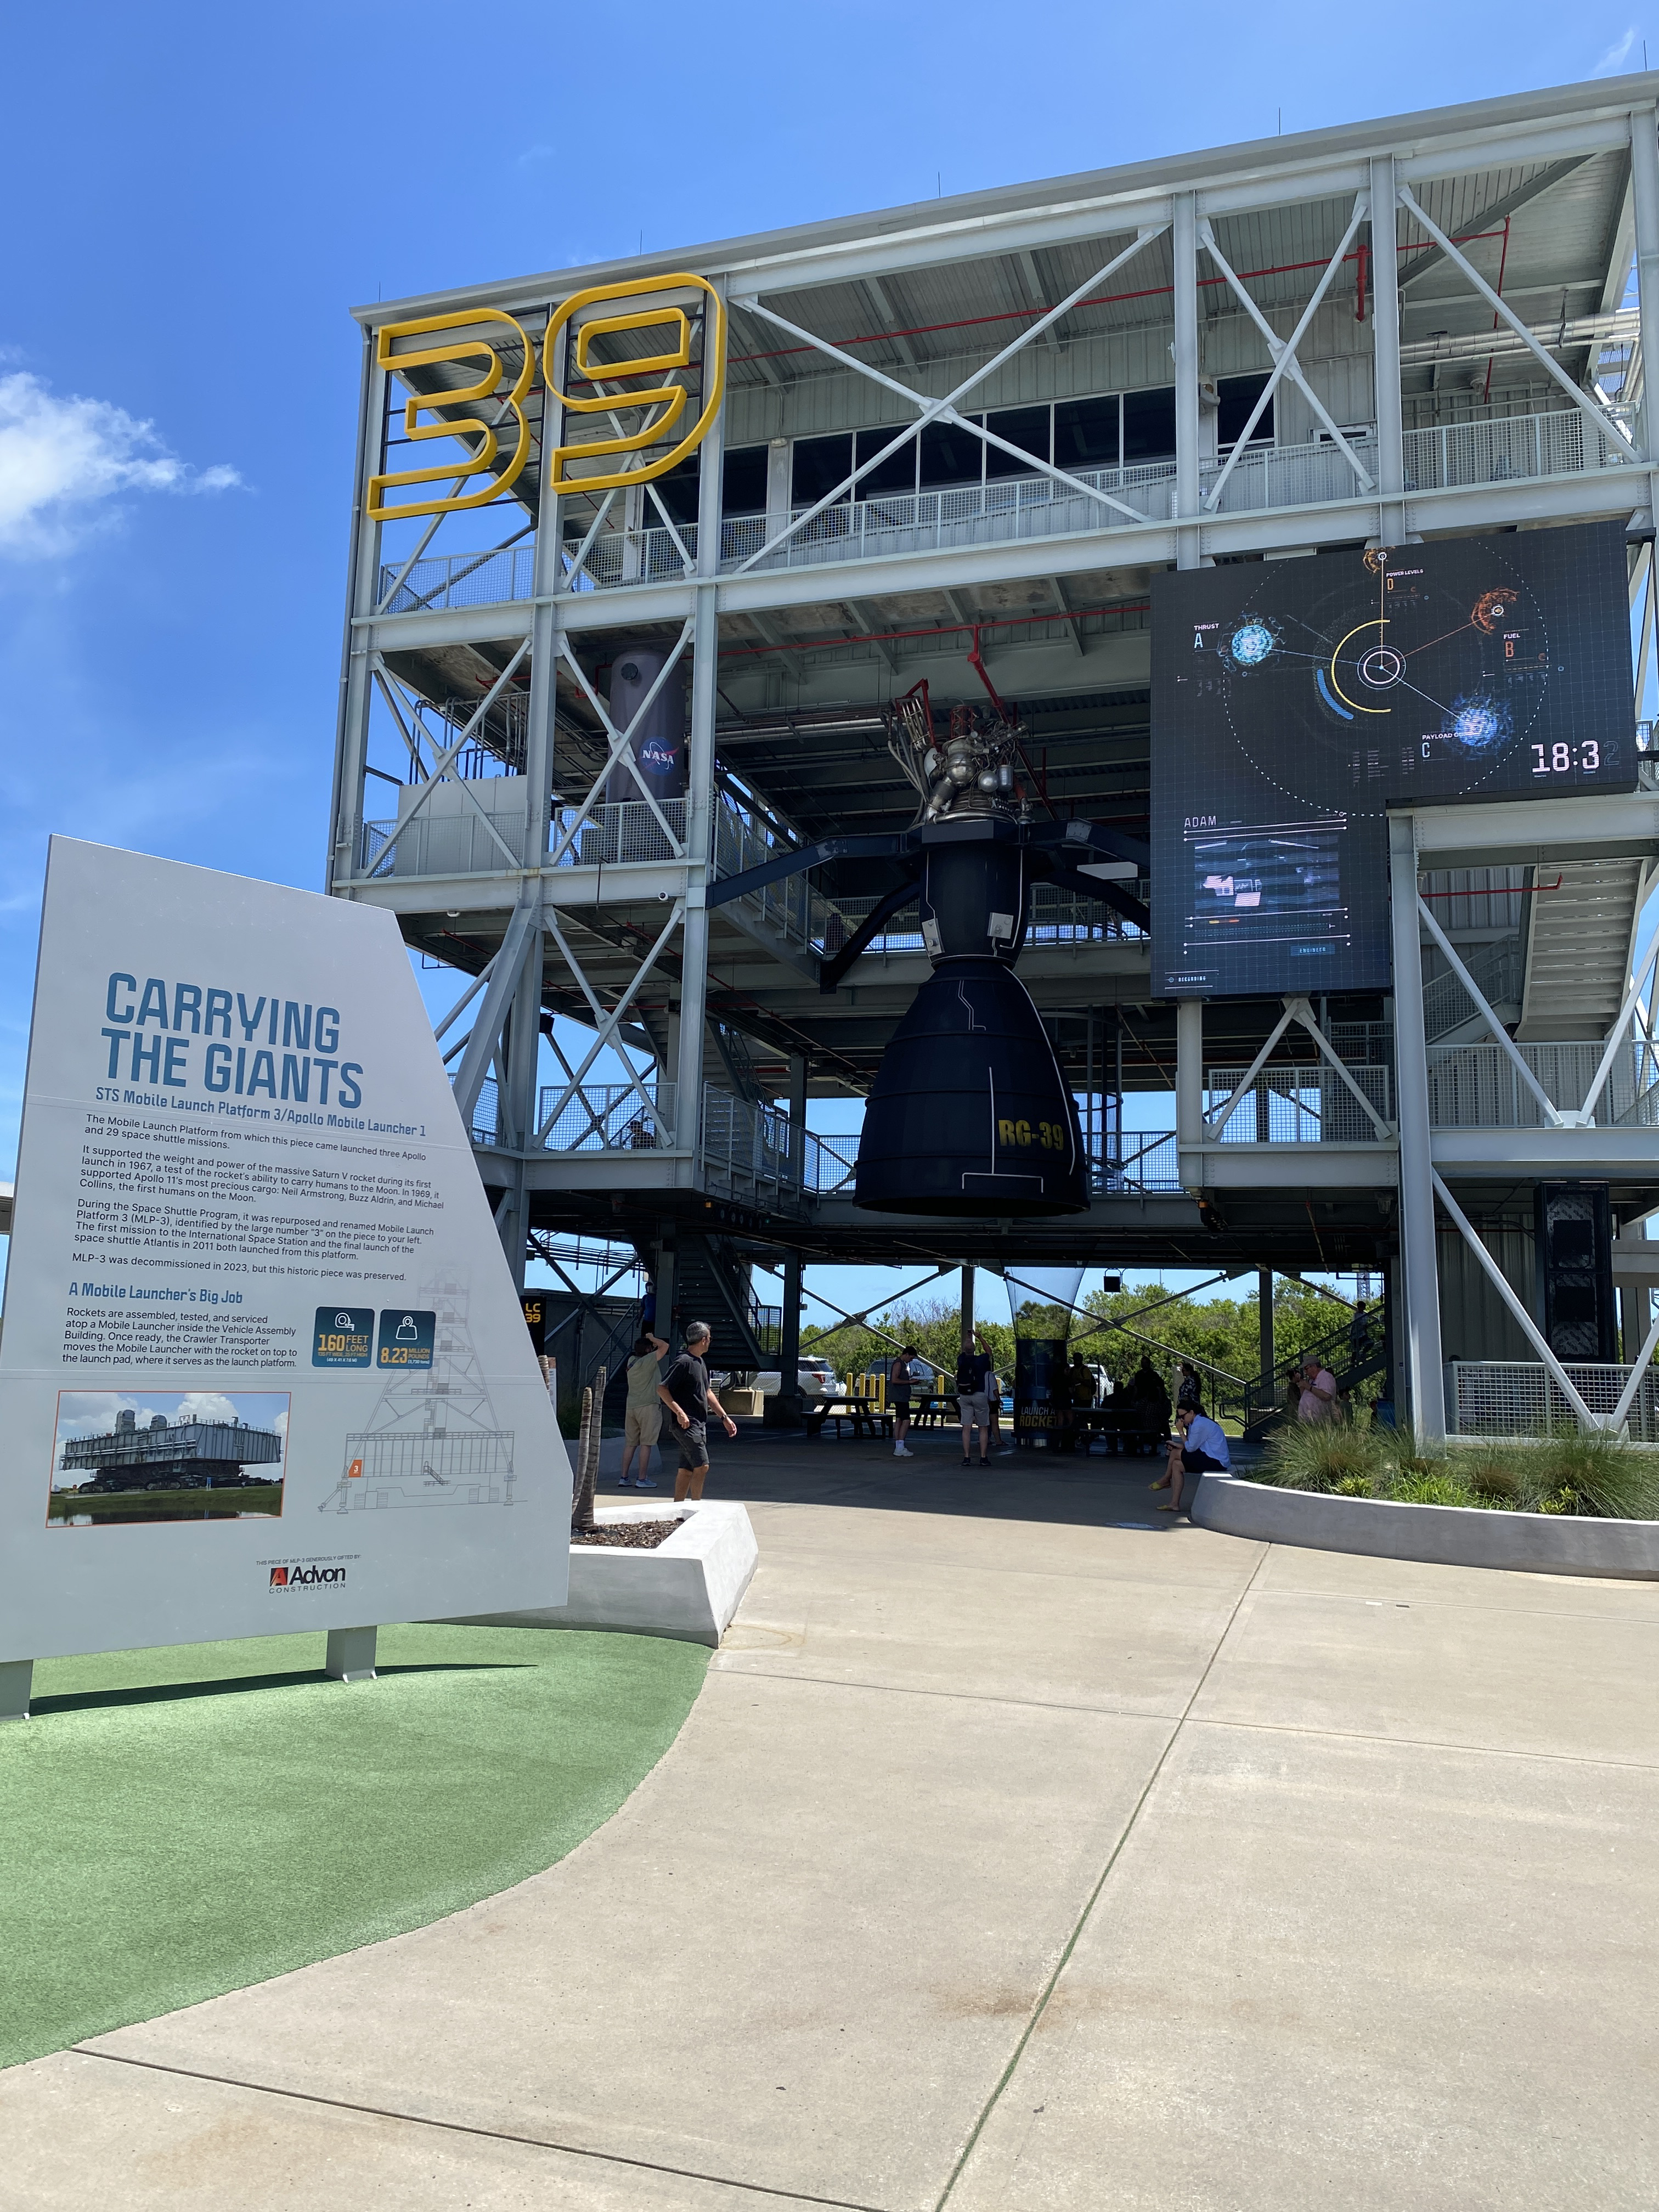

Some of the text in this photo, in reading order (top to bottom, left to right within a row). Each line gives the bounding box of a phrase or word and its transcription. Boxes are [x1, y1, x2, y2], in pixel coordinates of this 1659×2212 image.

[367, 273, 727, 522] 39
[1194, 633, 1203, 648] A
[1505, 641, 1514, 657] B
[642, 749, 674, 765] NASA
[1421, 742, 1431, 758] C
[1184, 815, 1217, 828] ADAM
[106, 972, 340, 1054] CARRYING
[101, 1028, 364, 1109] THE GIANTS
[95, 1087, 425, 1136] STS Mobile Launch Platform 3/Apollo Mobile Launcher 1
[86, 1114, 104, 1124] The
[108, 1116, 139, 1127] Mobile
[143, 1120, 176, 1132] Launch
[179, 1125, 218, 1137] Platform
[221, 1130, 241, 1139] from
[244, 1133, 269, 1142] which
[272, 1136, 287, 1144] this
[290, 1138, 313, 1148] piece
[340, 1144, 377, 1155] launched
[379, 1149, 399, 1158] three
[402, 1151, 426, 1160] Apollo
[998, 1120, 1064, 1150] RG-39
[76, 1210, 118, 1221] Platform
[131, 1213, 172, 1227] (MLP-3),
[175, 1217, 218, 1228] identified
[221, 1221, 232, 1231] by
[234, 1223, 249, 1231] the
[251, 1224, 273, 1234] large
[338, 1231, 351, 1239] the
[78, 1198, 110, 1211] During
[113, 1201, 128, 1210] the
[132, 1203, 161, 1214] Space
[164, 1206, 197, 1216] Shuttle
[200, 1209, 240, 1221] Program,
[271, 1216, 320, 1226] repurposed
[378, 1223, 404, 1233] Mobile
[406, 1226, 433, 1235] Launch
[69, 1282, 242, 1304] A Mobile Launcher's Big Job
[67, 1307, 105, 1317] Rockets
[126, 1311, 177, 1321] assembled,
[180, 1312, 210, 1323] tested,
[231, 1314, 267, 1323] serviced
[526, 1303, 541, 1312] LC
[525, 1313, 541, 1323] 39
[65, 1319, 87, 1329] atop
[98, 1320, 129, 1329] Mobile
[132, 1321, 174, 1330] Launcher
[177, 1323, 203, 1331] inside
[222, 1324, 253, 1334] Vehicle
[255, 1326, 296, 1336] Assembly
[65, 1330, 270, 1346] Building. Once ready, the Crawler Transporter
[318, 1334, 369, 1352] 160 FEET
[98, 1343, 113, 1351] the
[116, 1344, 147, 1352] Mobile
[150, 1345, 191, 1353] Launcher
[194, 1346, 212, 1354] with
[215, 1346, 229, 1355] the
[231, 1347, 258, 1355] rocket
[273, 1348, 286, 1357] top
[346, 1344, 368, 1352] LONG
[381, 1347, 408, 1363] 8.23
[62, 1353, 77, 1362] the
[80, 1354, 110, 1363] launch
[112, 1355, 132, 1365] pad,
[135, 1356, 163, 1364] where
[165, 1356, 171, 1364] it
[216, 1357, 229, 1365] the
[231, 1358, 258, 1366] launch
[261, 1358, 296, 1368] platform.
[1021, 1407, 1049, 1415] LAUNCH
[289, 1565, 346, 1585] Advon
[268, 1582, 346, 1594] CONSTRUCTION
